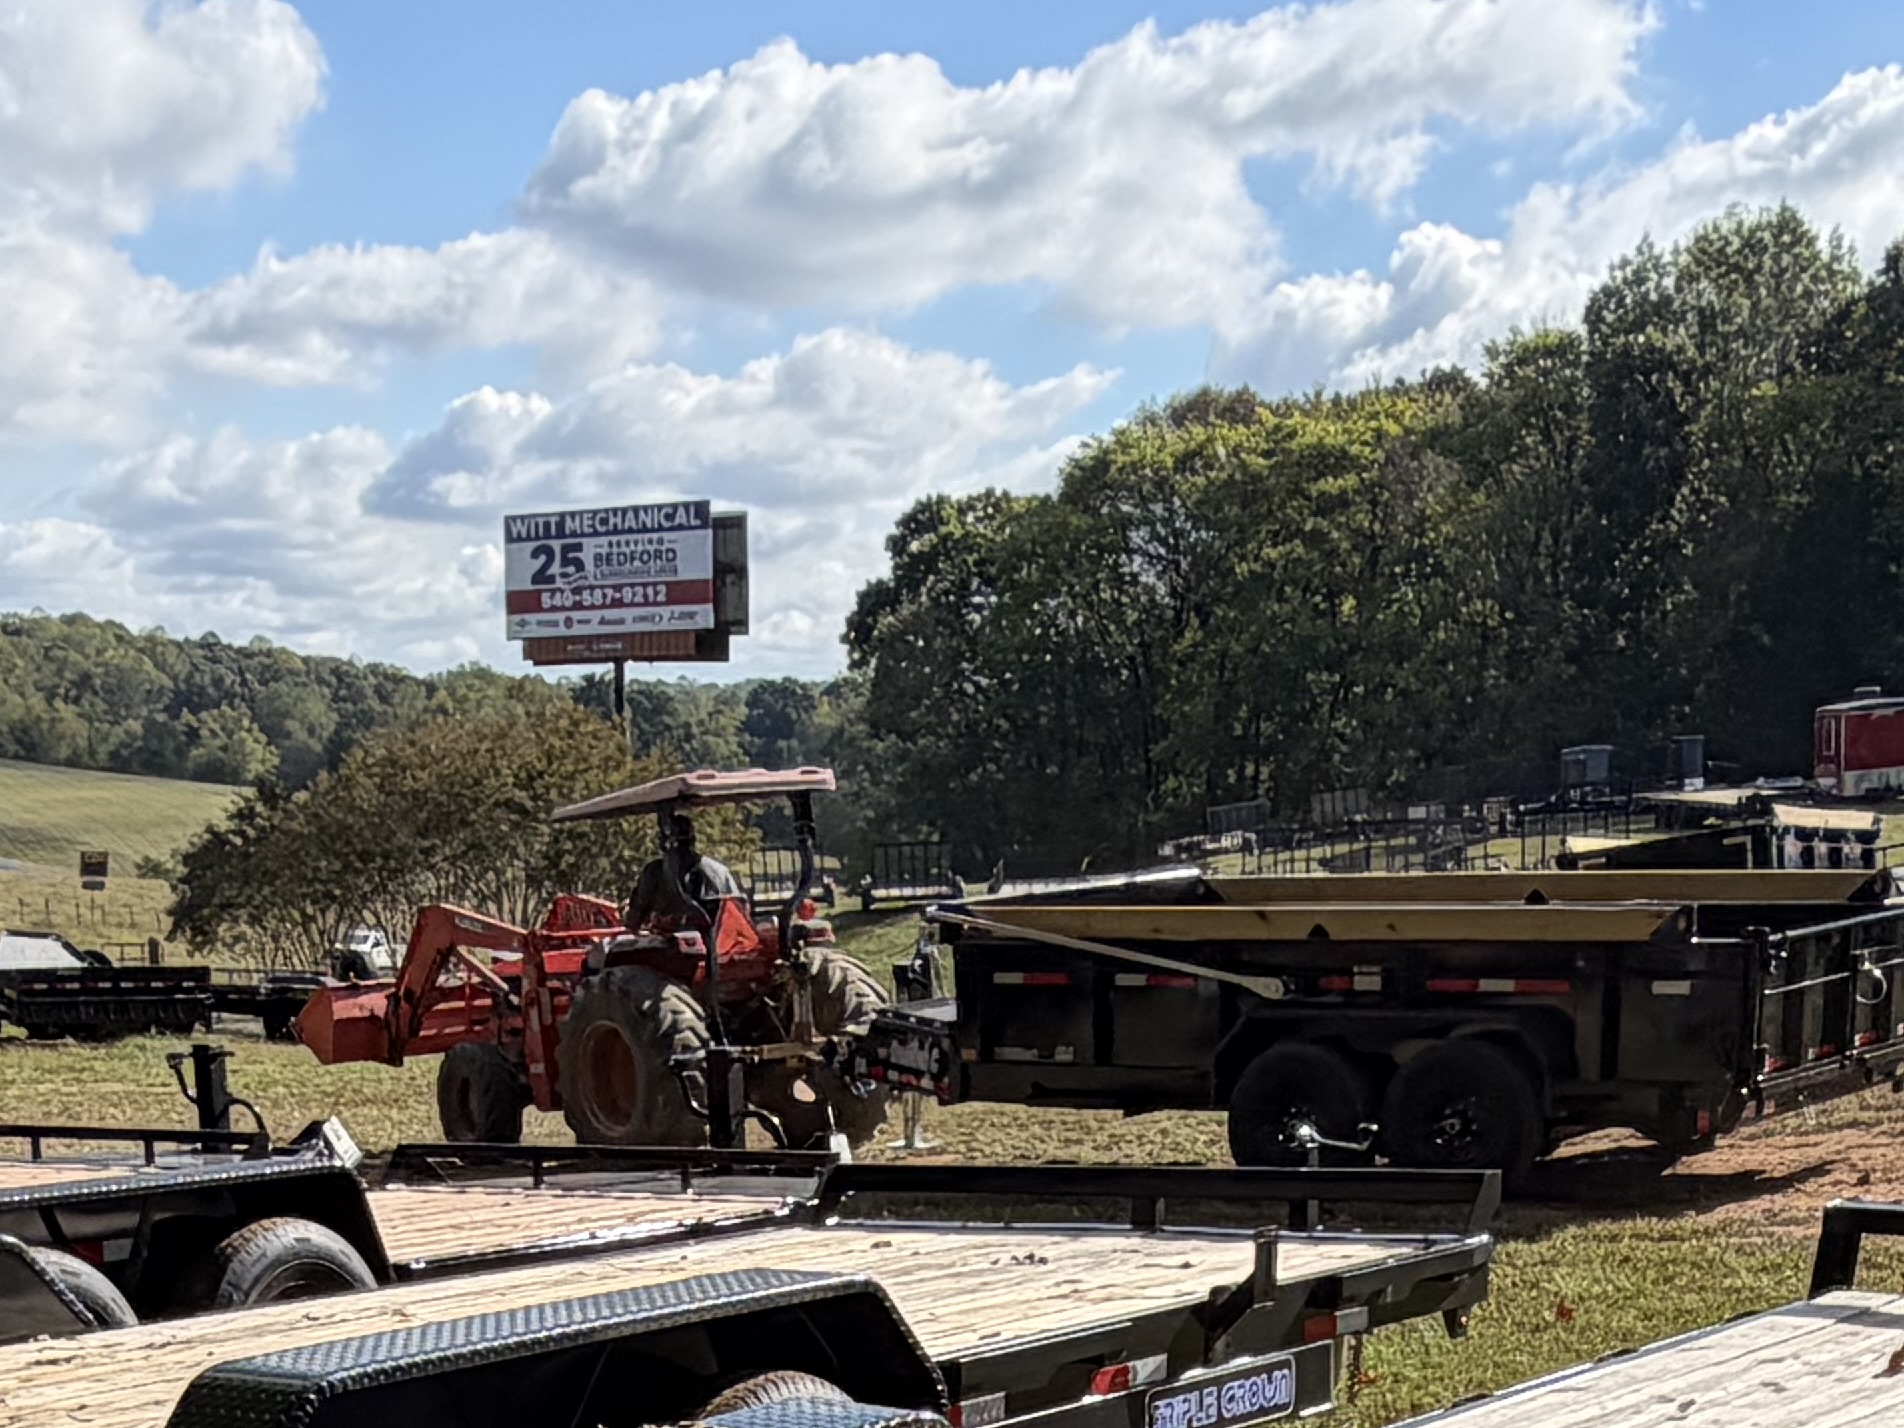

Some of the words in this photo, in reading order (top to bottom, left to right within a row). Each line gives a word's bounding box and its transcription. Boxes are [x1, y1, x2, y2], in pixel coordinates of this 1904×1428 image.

[508, 517, 559, 539] WITT
[564, 504, 702, 535] MECHANICAL
[530, 542, 585, 586] 25
[593, 548, 677, 568] BEDFORD
[1221, 1369, 1290, 1418] CROWN
